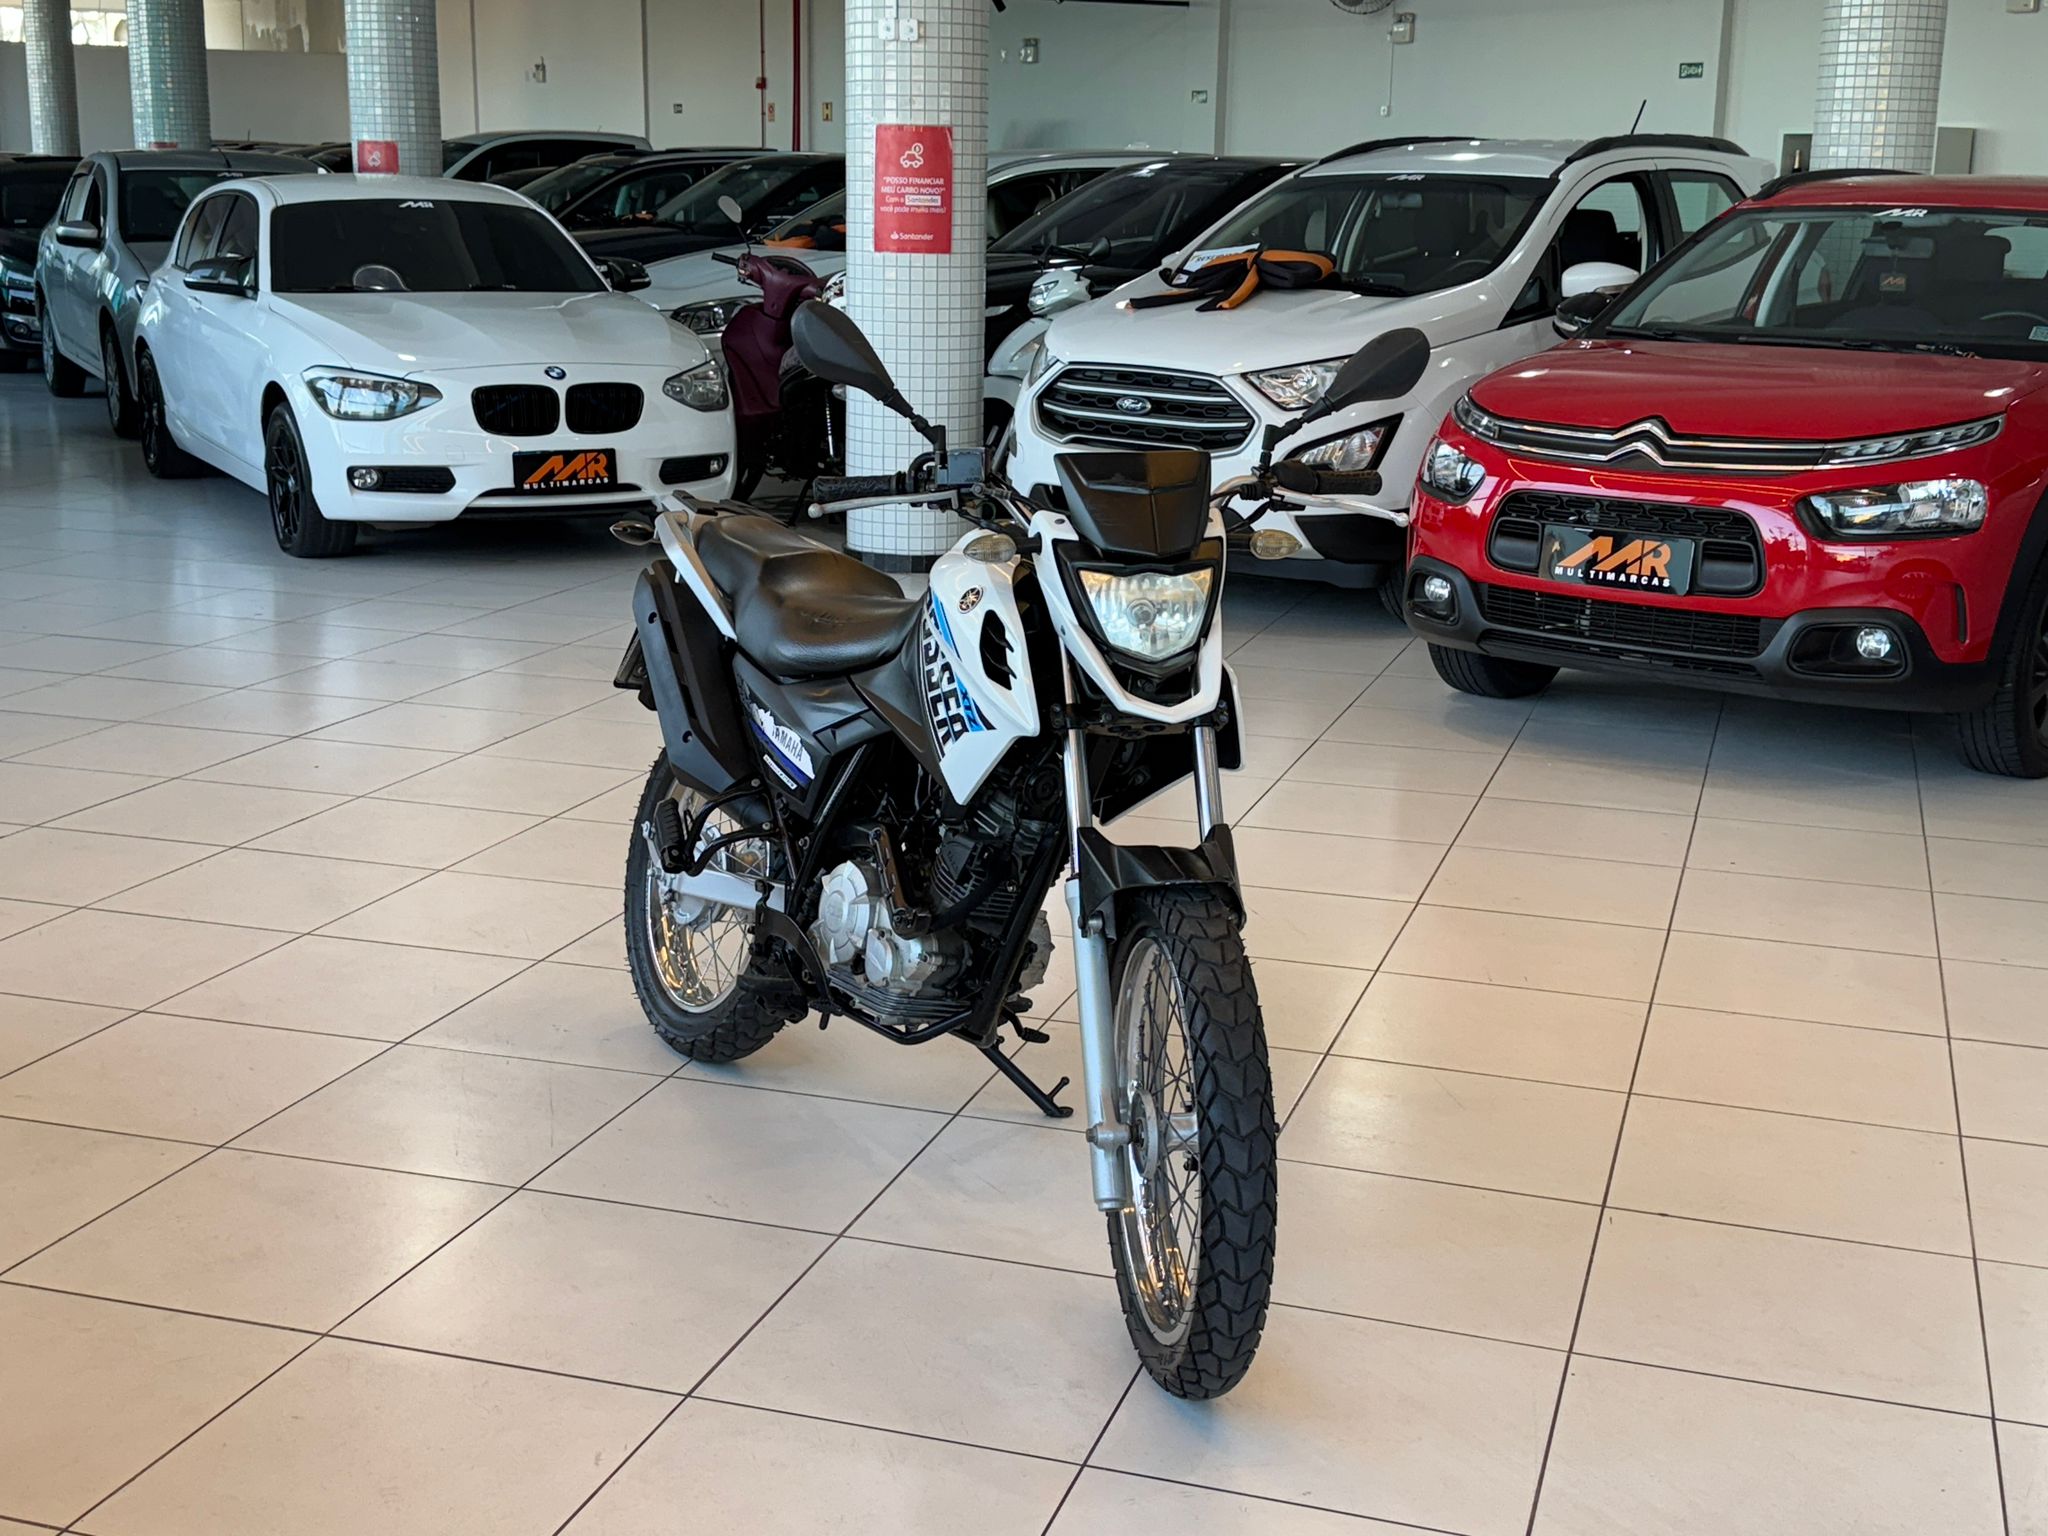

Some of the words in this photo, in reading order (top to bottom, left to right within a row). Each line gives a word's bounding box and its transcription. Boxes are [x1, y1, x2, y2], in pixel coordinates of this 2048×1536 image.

[909, 177, 944, 185] FINANCIAR
[897, 186, 919, 194] CARRO
[900, 233, 934, 241] Santander
[523, 477, 608, 490] MULTIMARCAS
[1554, 566, 1671, 588] MULTIMARCAS
[922, 586, 970, 746] OSSER
[961, 689, 980, 727] XTZ
